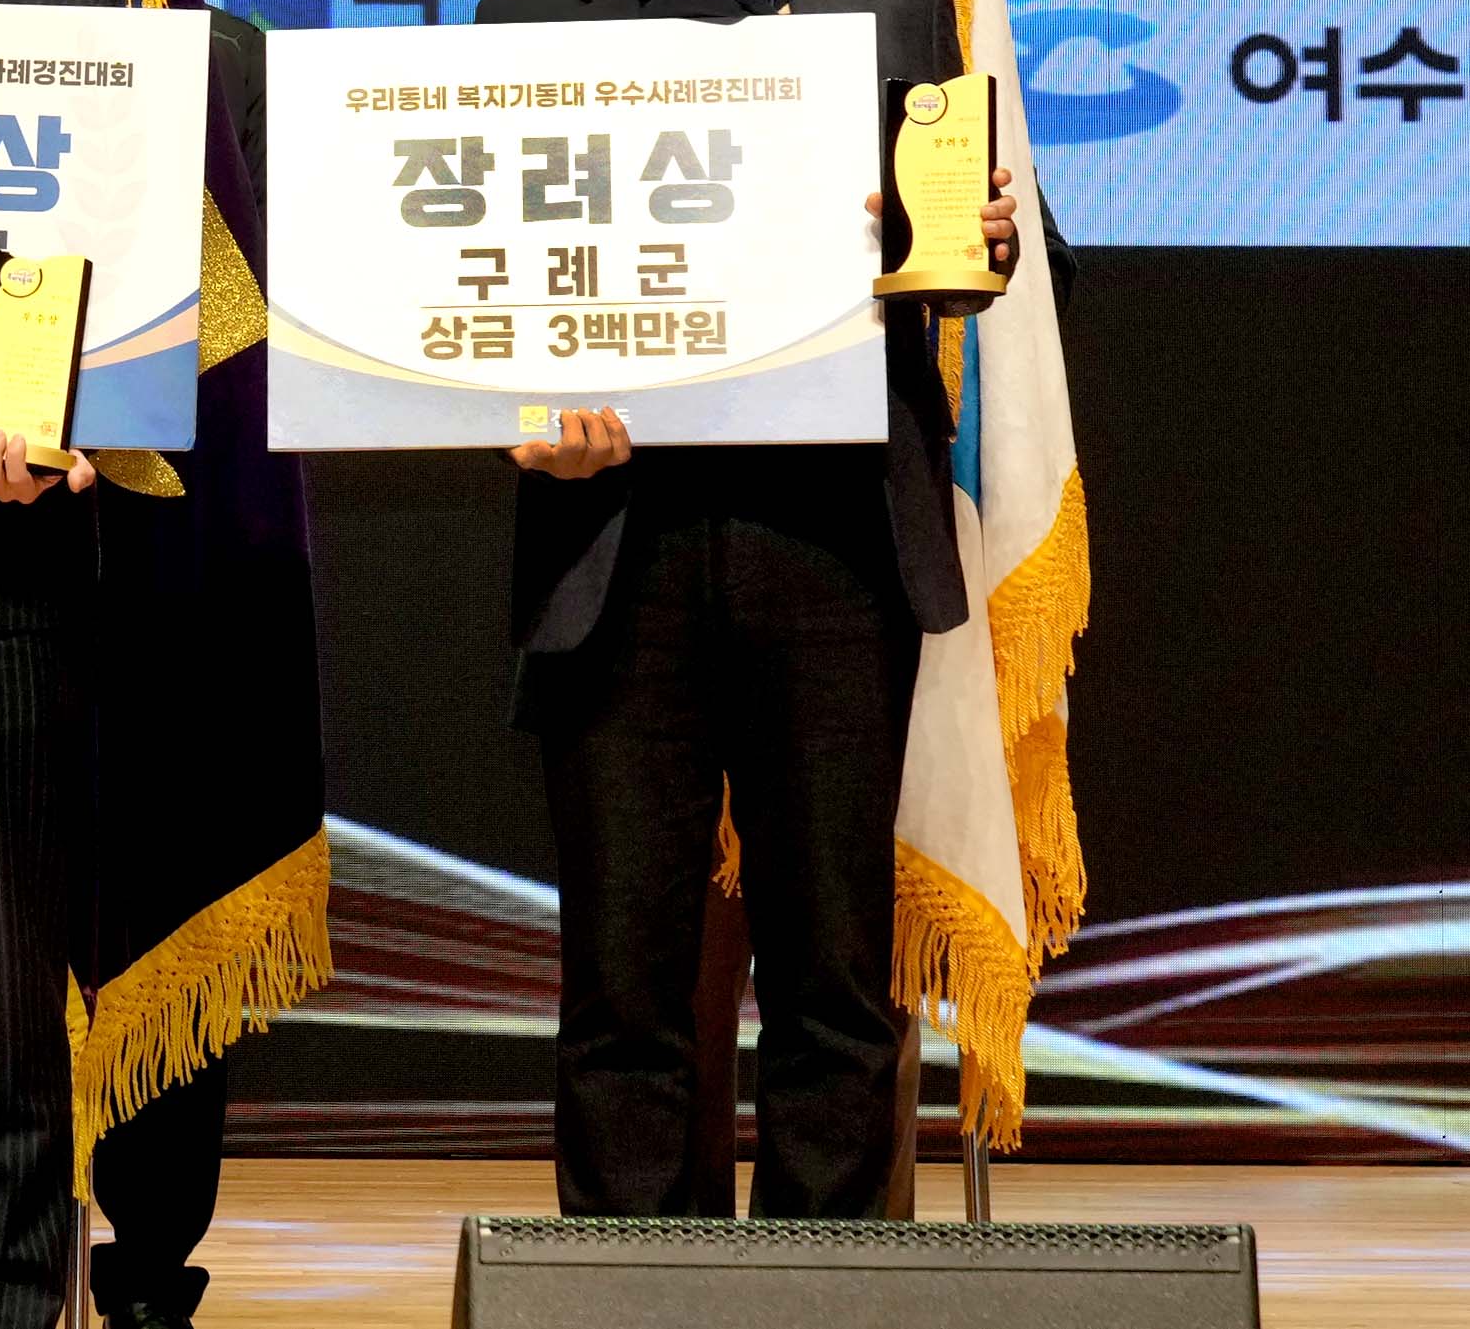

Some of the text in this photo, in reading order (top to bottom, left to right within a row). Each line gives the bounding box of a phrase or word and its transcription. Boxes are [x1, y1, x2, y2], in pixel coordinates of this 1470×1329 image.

[345, 76, 802, 114] 우리동네 복지기동대 우수사례경진대회
[1230, 25, 1465, 123] 여수
[392, 129, 743, 228] 장려상
[458, 243, 689, 301] 구례군
[420, 310, 728, 361] 상금 3백만원
